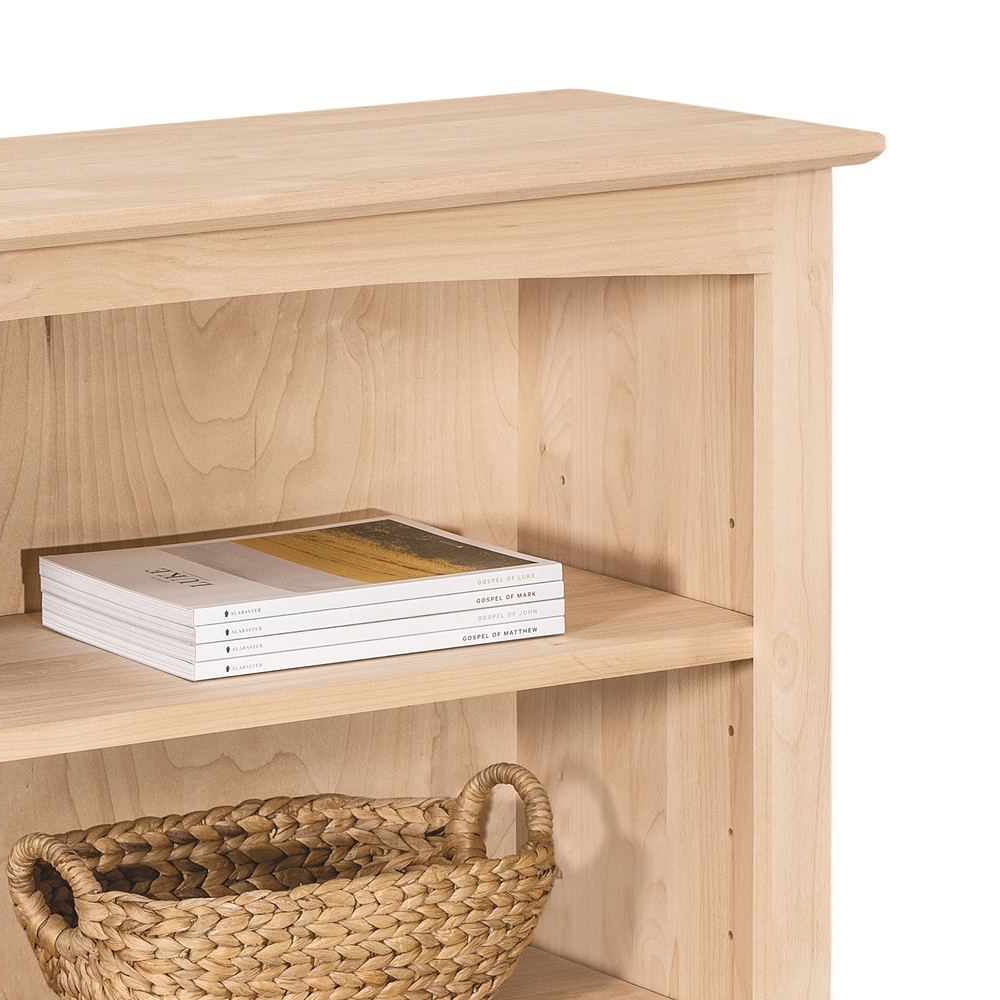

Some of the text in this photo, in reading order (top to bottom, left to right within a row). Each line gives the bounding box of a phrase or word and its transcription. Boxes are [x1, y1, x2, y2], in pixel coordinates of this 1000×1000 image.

[145, 567, 213, 588] LUKE
[478, 577, 504, 586] GOSPEL
[476, 596, 502, 604] GOSPEL
[231, 608, 261, 616] ALABASTER
[478, 614, 504, 622] GOSPEL
[231, 626, 262, 635] ALABASTER
[462, 634, 489, 642] GOSPEL
[504, 627, 538, 636] MATTHEW
[232, 644, 263, 652] ALABASTER
[232, 663, 262, 671] ALABASTER
